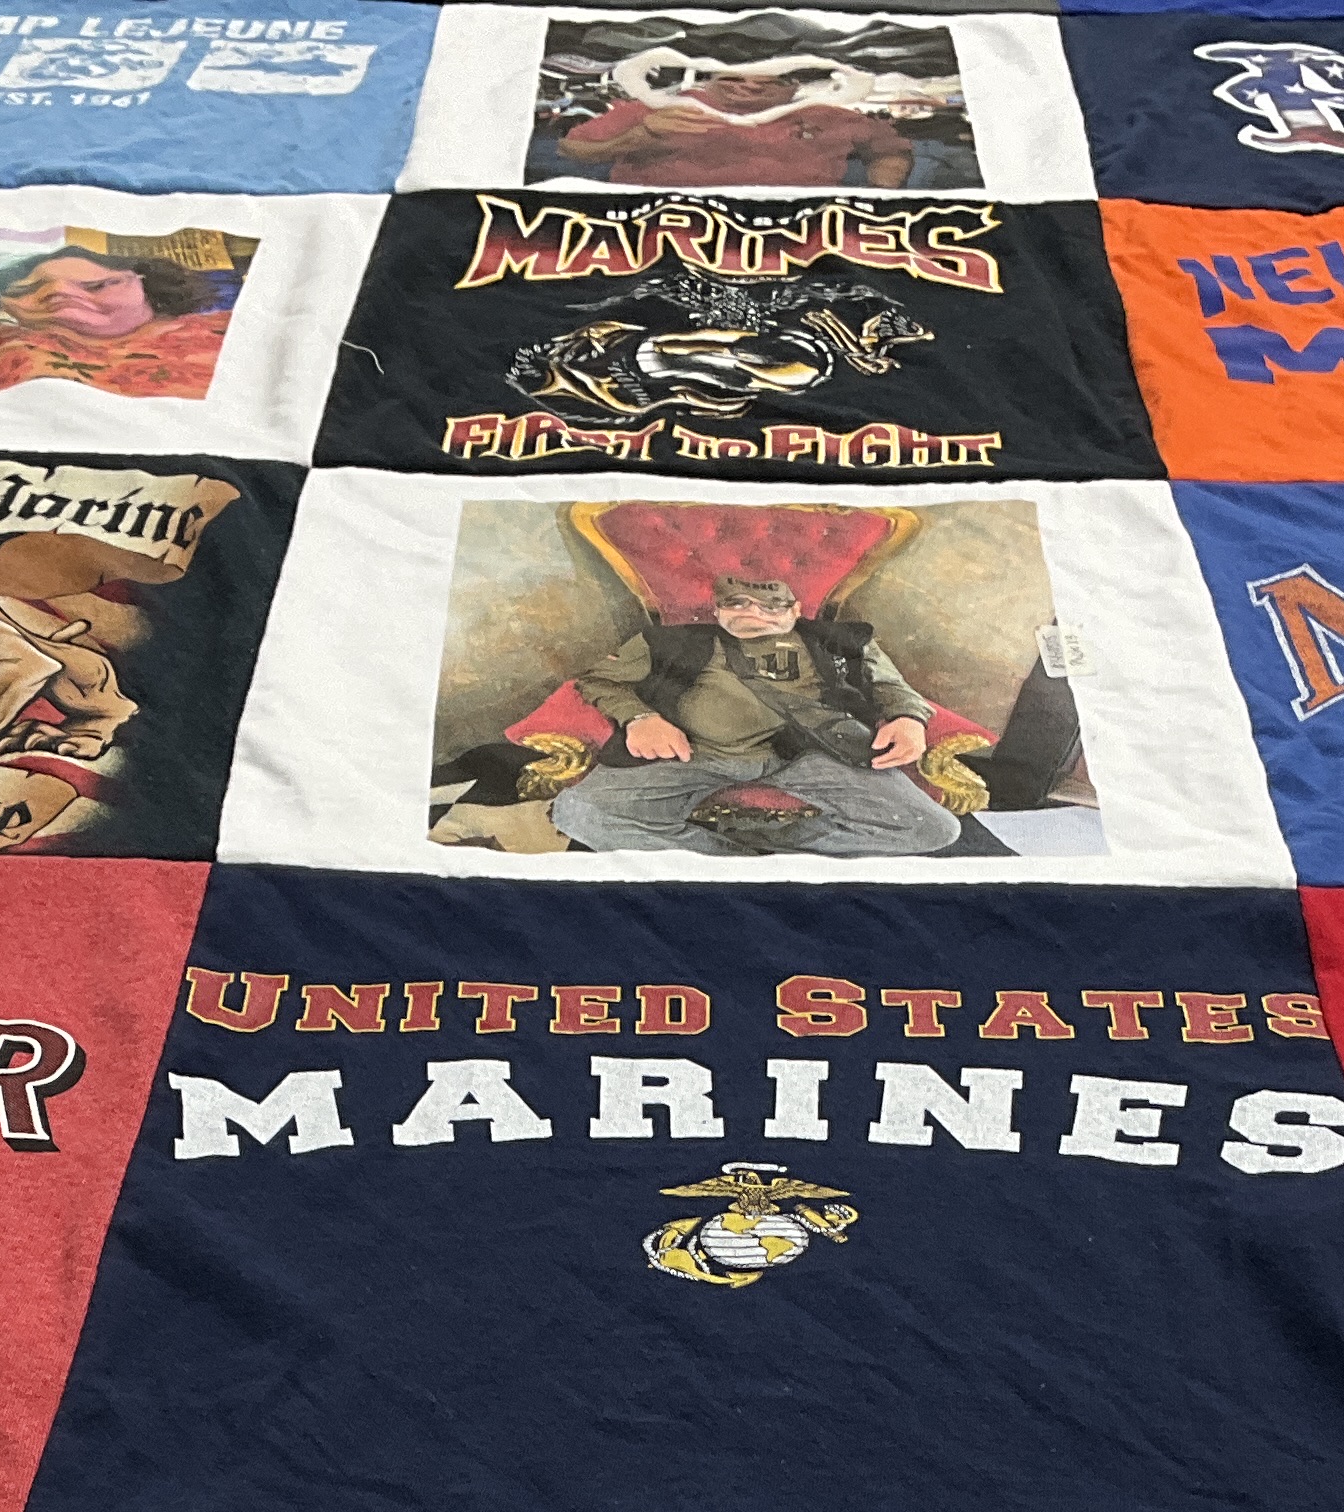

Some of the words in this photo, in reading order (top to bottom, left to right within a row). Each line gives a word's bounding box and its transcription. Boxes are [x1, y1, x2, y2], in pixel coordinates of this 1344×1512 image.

[79, 14, 348, 41] LEJEUNE
[456, 194, 1004, 294] MARINES
[760, 422, 1002, 468] FIGHT
[186, 966, 712, 1035] UNITED
[775, 974, 1332, 1044] STATES
